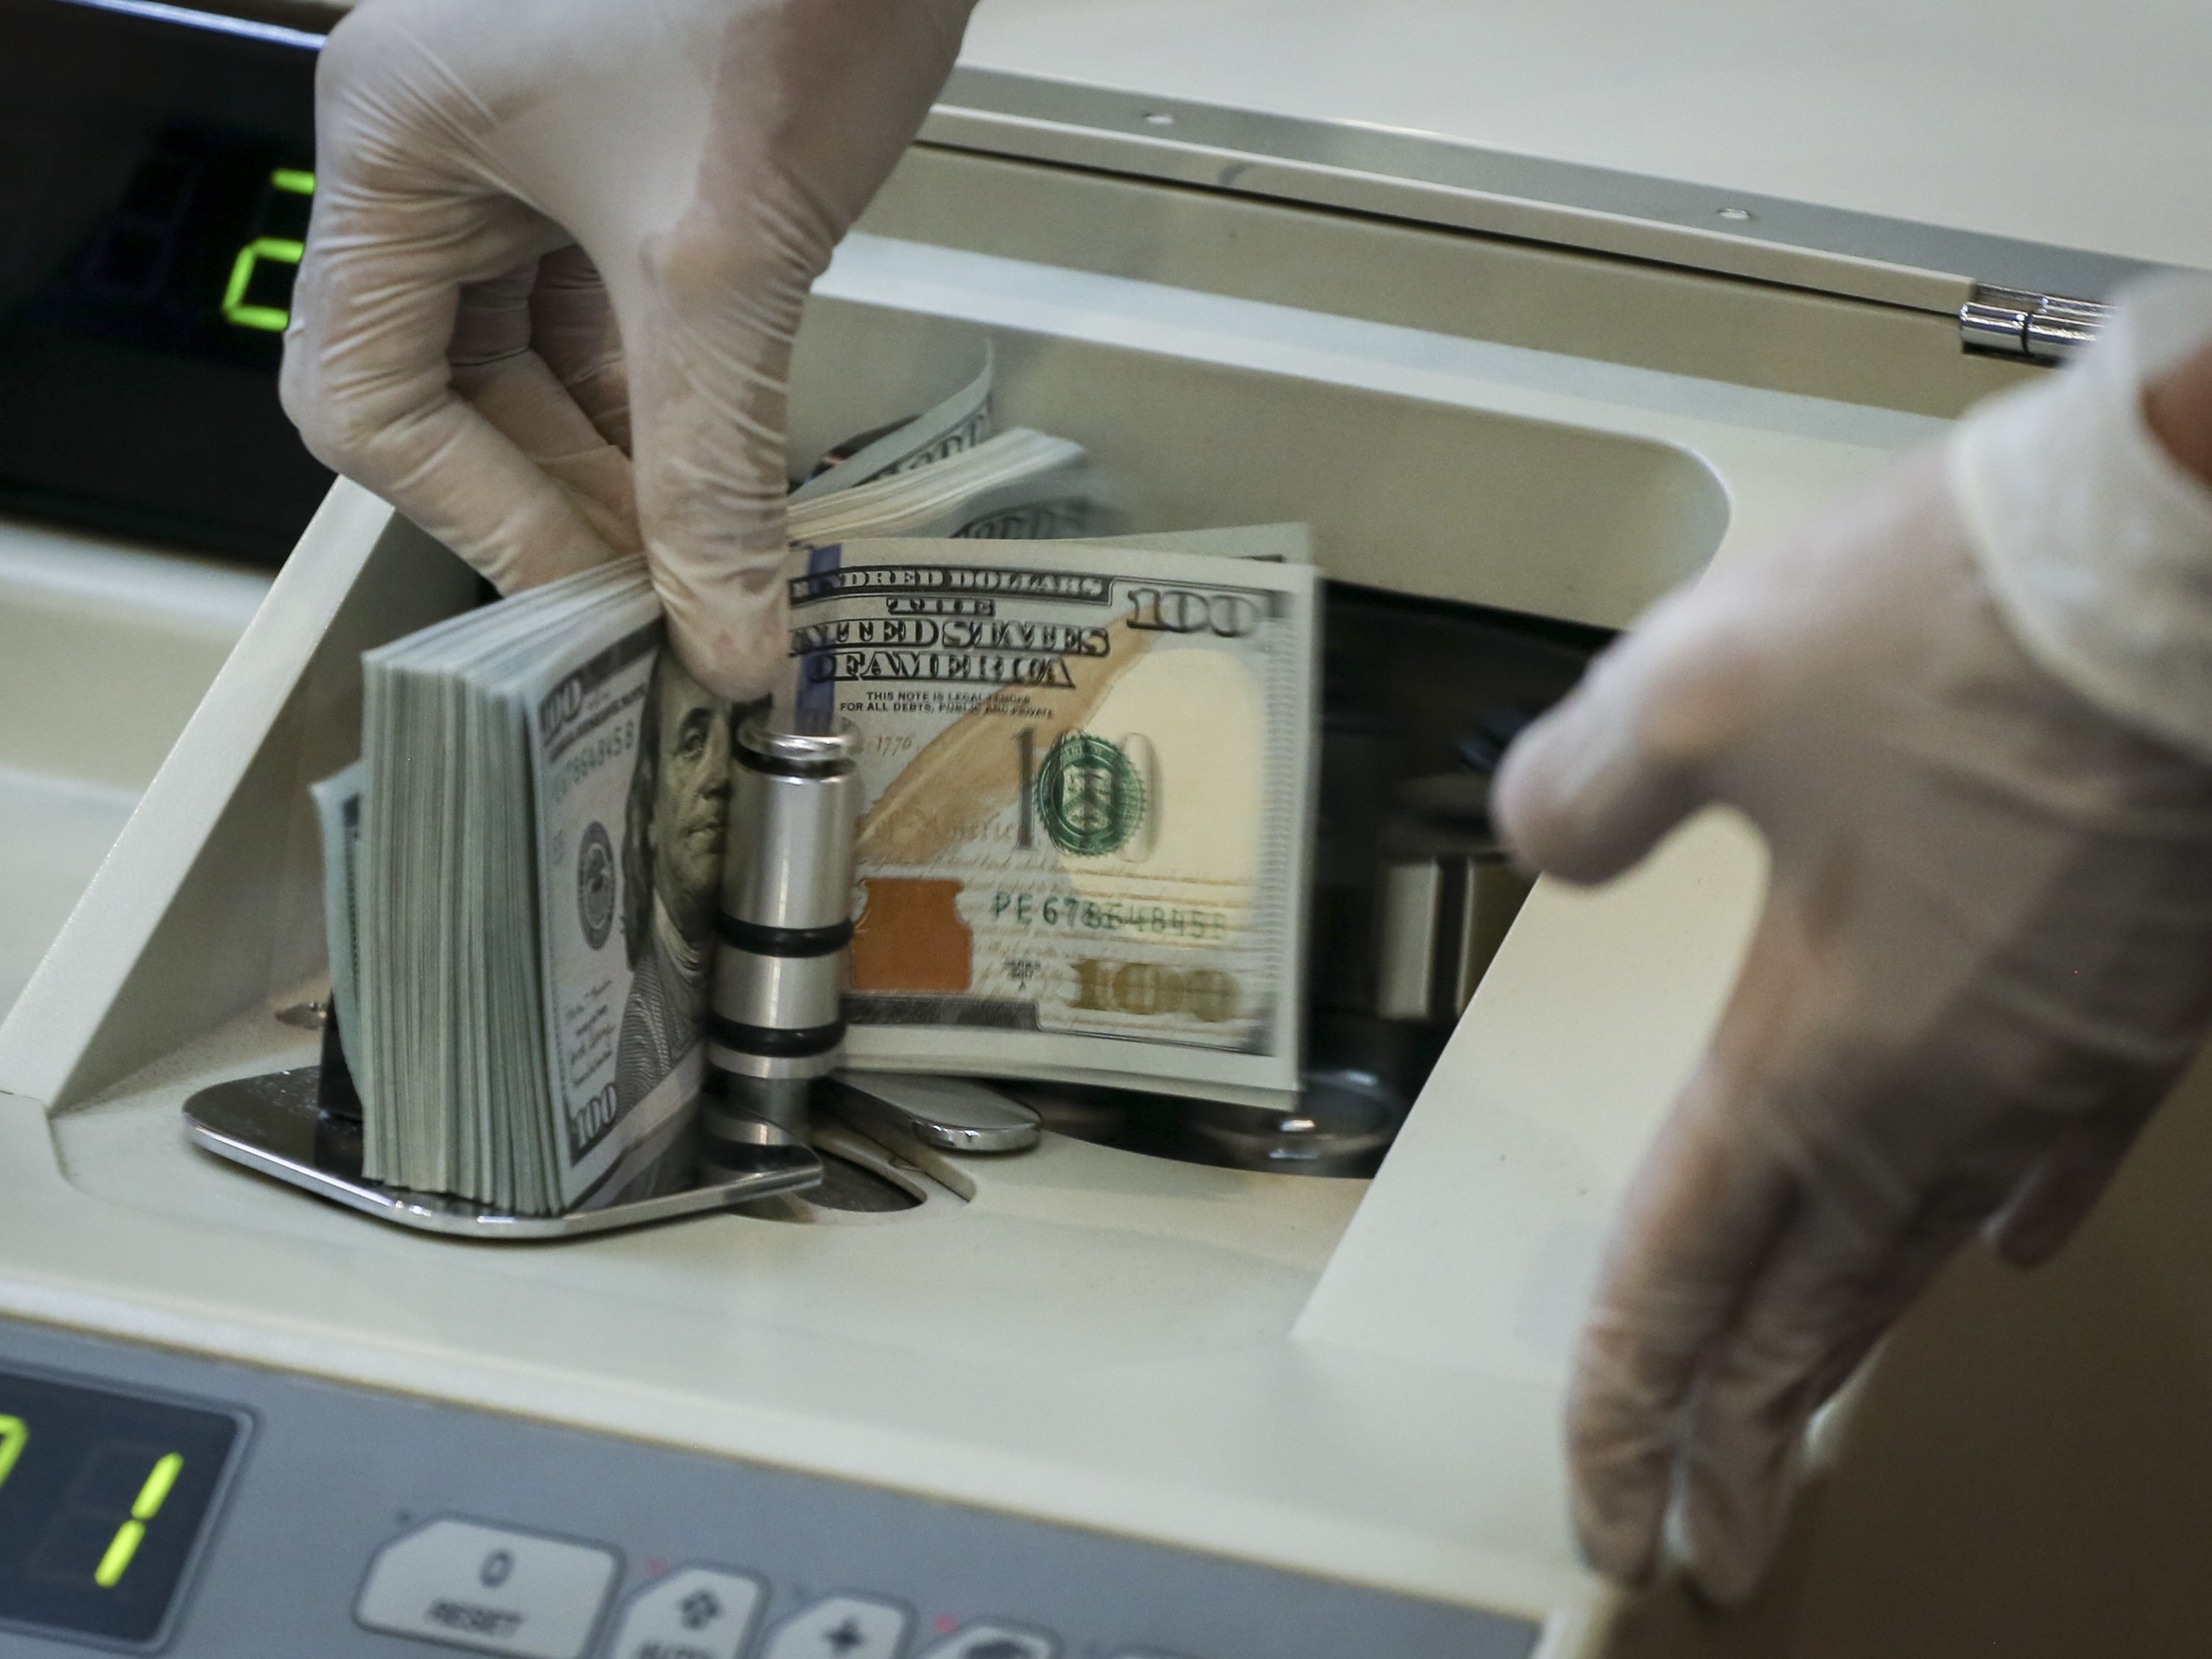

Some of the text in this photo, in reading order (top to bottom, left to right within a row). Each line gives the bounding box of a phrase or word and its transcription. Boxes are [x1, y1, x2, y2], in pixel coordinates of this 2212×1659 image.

[1127, 588, 1260, 638] 100
[943, 619, 1110, 657] STATES
[860, 650, 1076, 689] AMERICA
[840, 702, 863, 712] FOR
[867, 702, 888, 712] ALL
[938, 704, 980, 714] PUBLIC
[866, 691, 894, 701] THIS
[898, 691, 929, 701] NOTE
[933, 692, 944, 701] IS
[949, 692, 984, 701] LEGAL
[571, 1082, 619, 1150] 100
